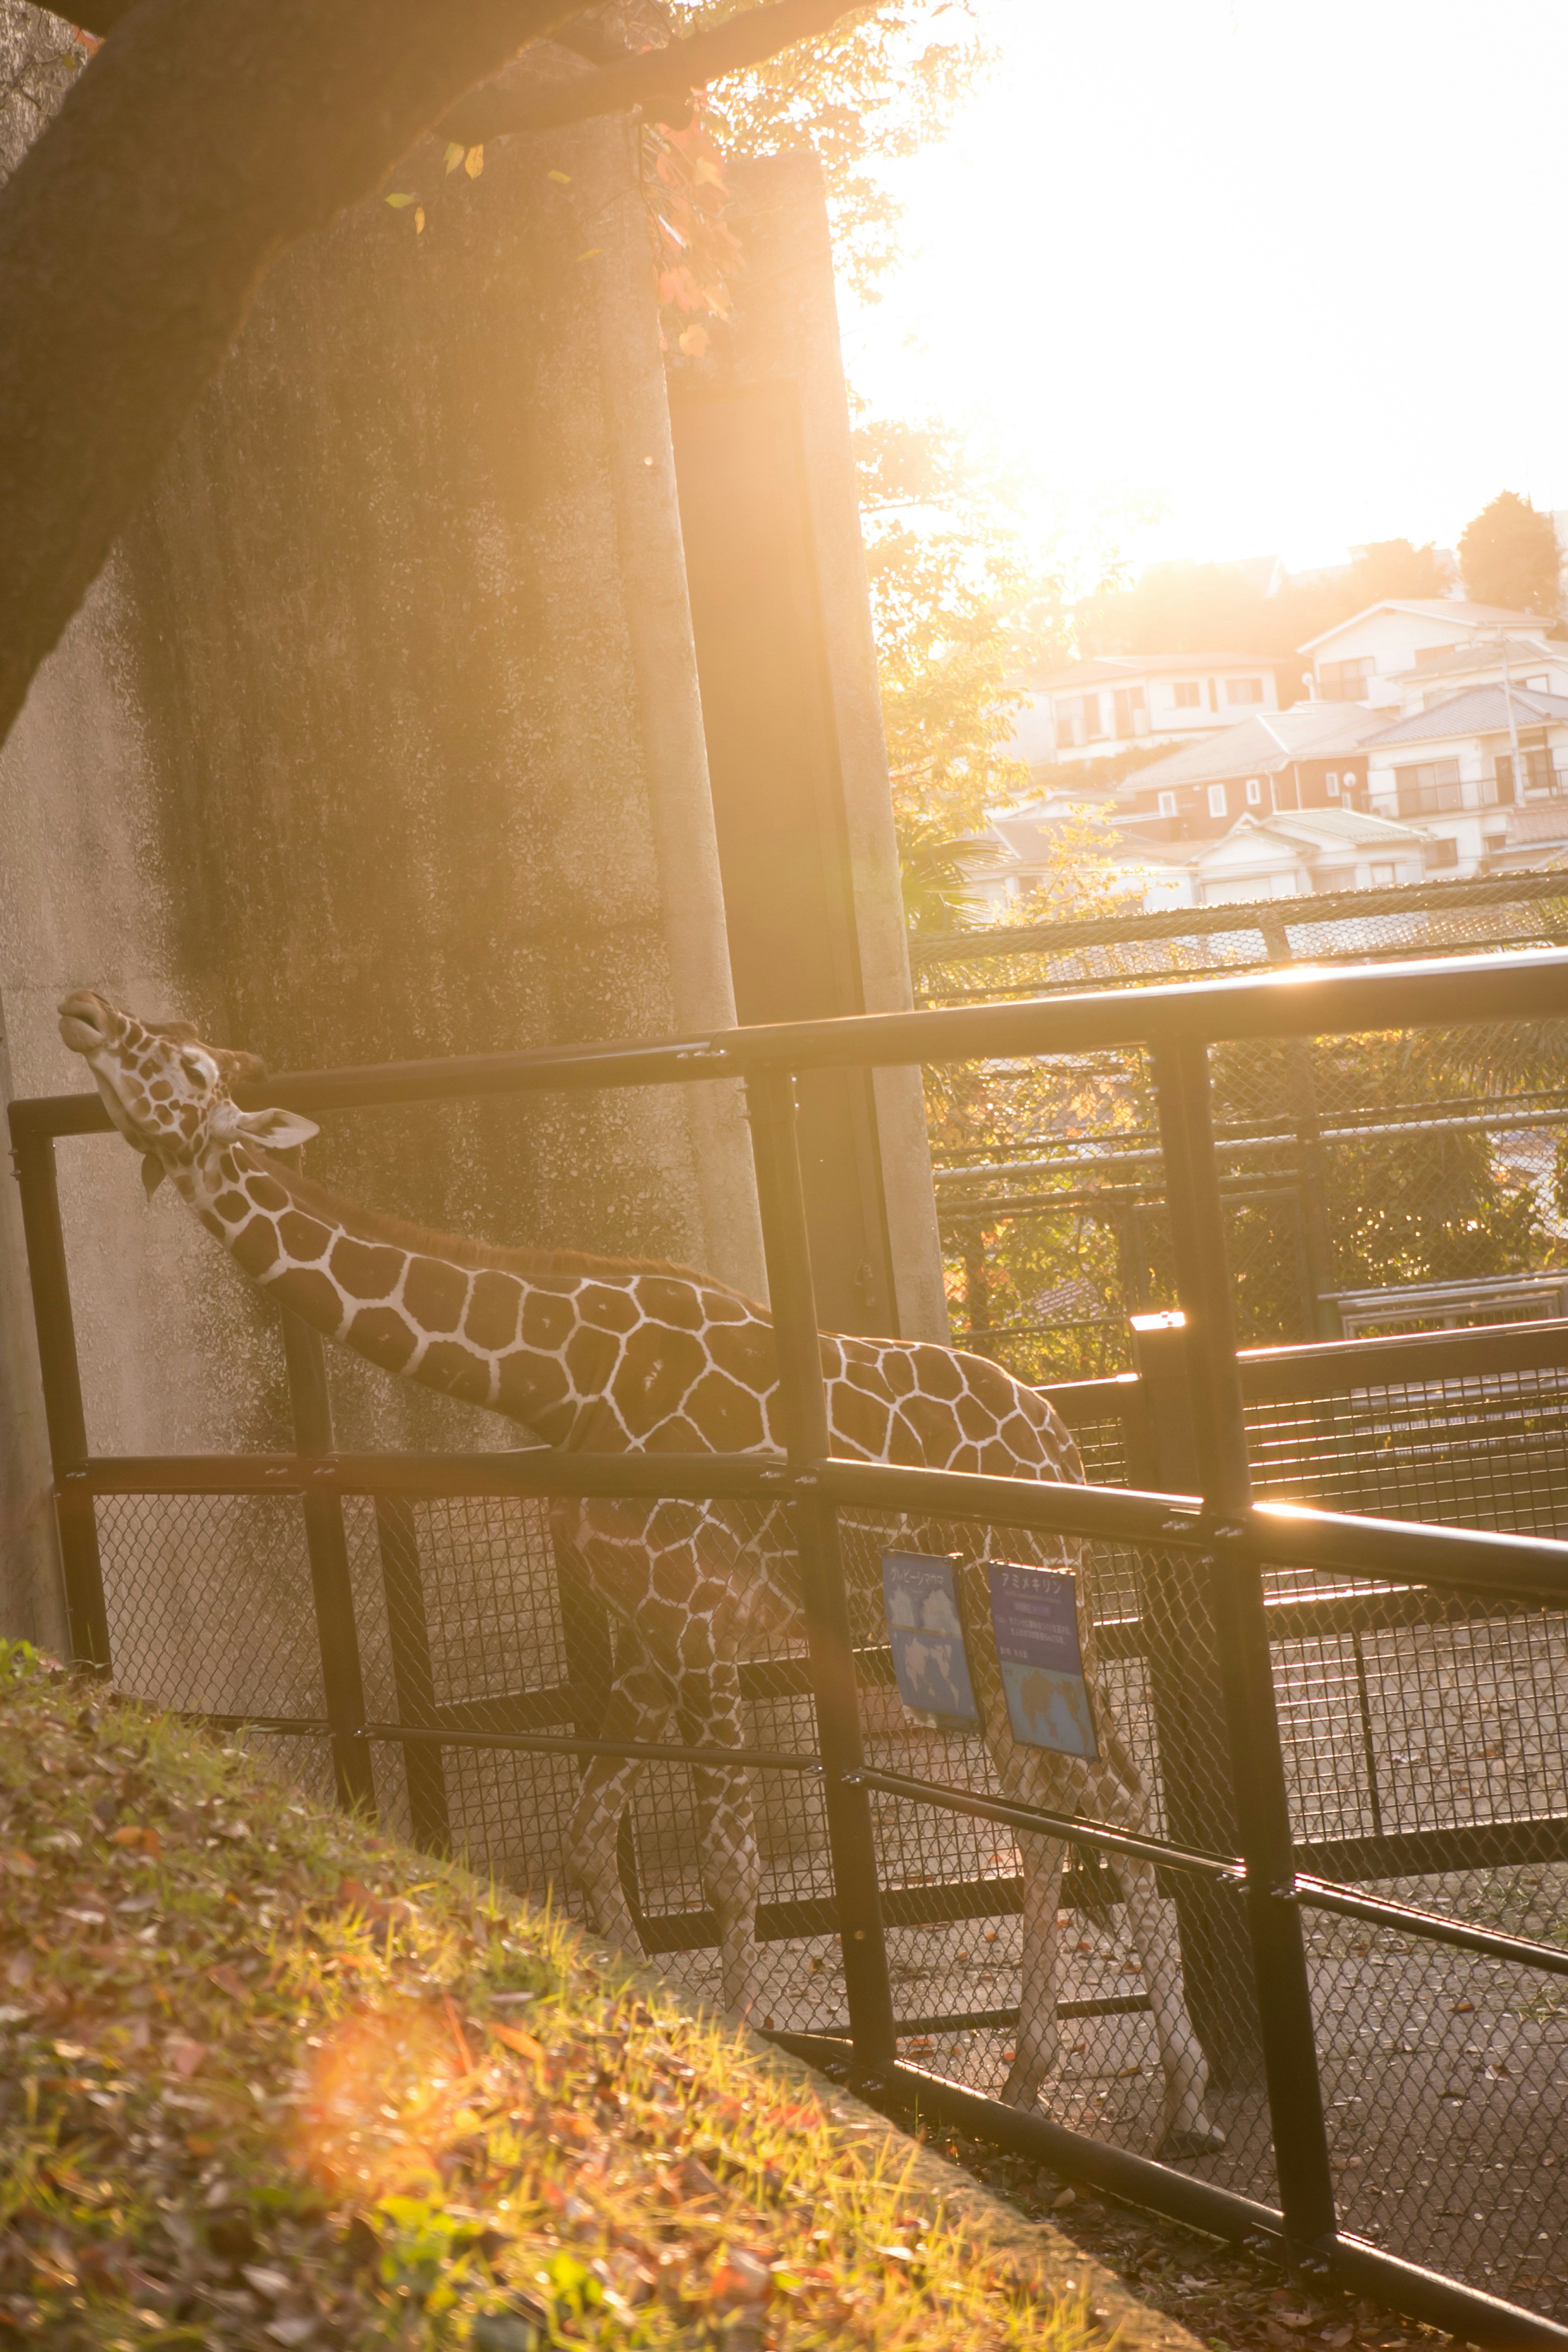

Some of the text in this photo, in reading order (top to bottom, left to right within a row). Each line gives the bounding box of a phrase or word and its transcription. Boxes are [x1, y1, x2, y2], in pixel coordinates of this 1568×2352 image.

[1002, 1572, 1061, 1594] アミメキリン
